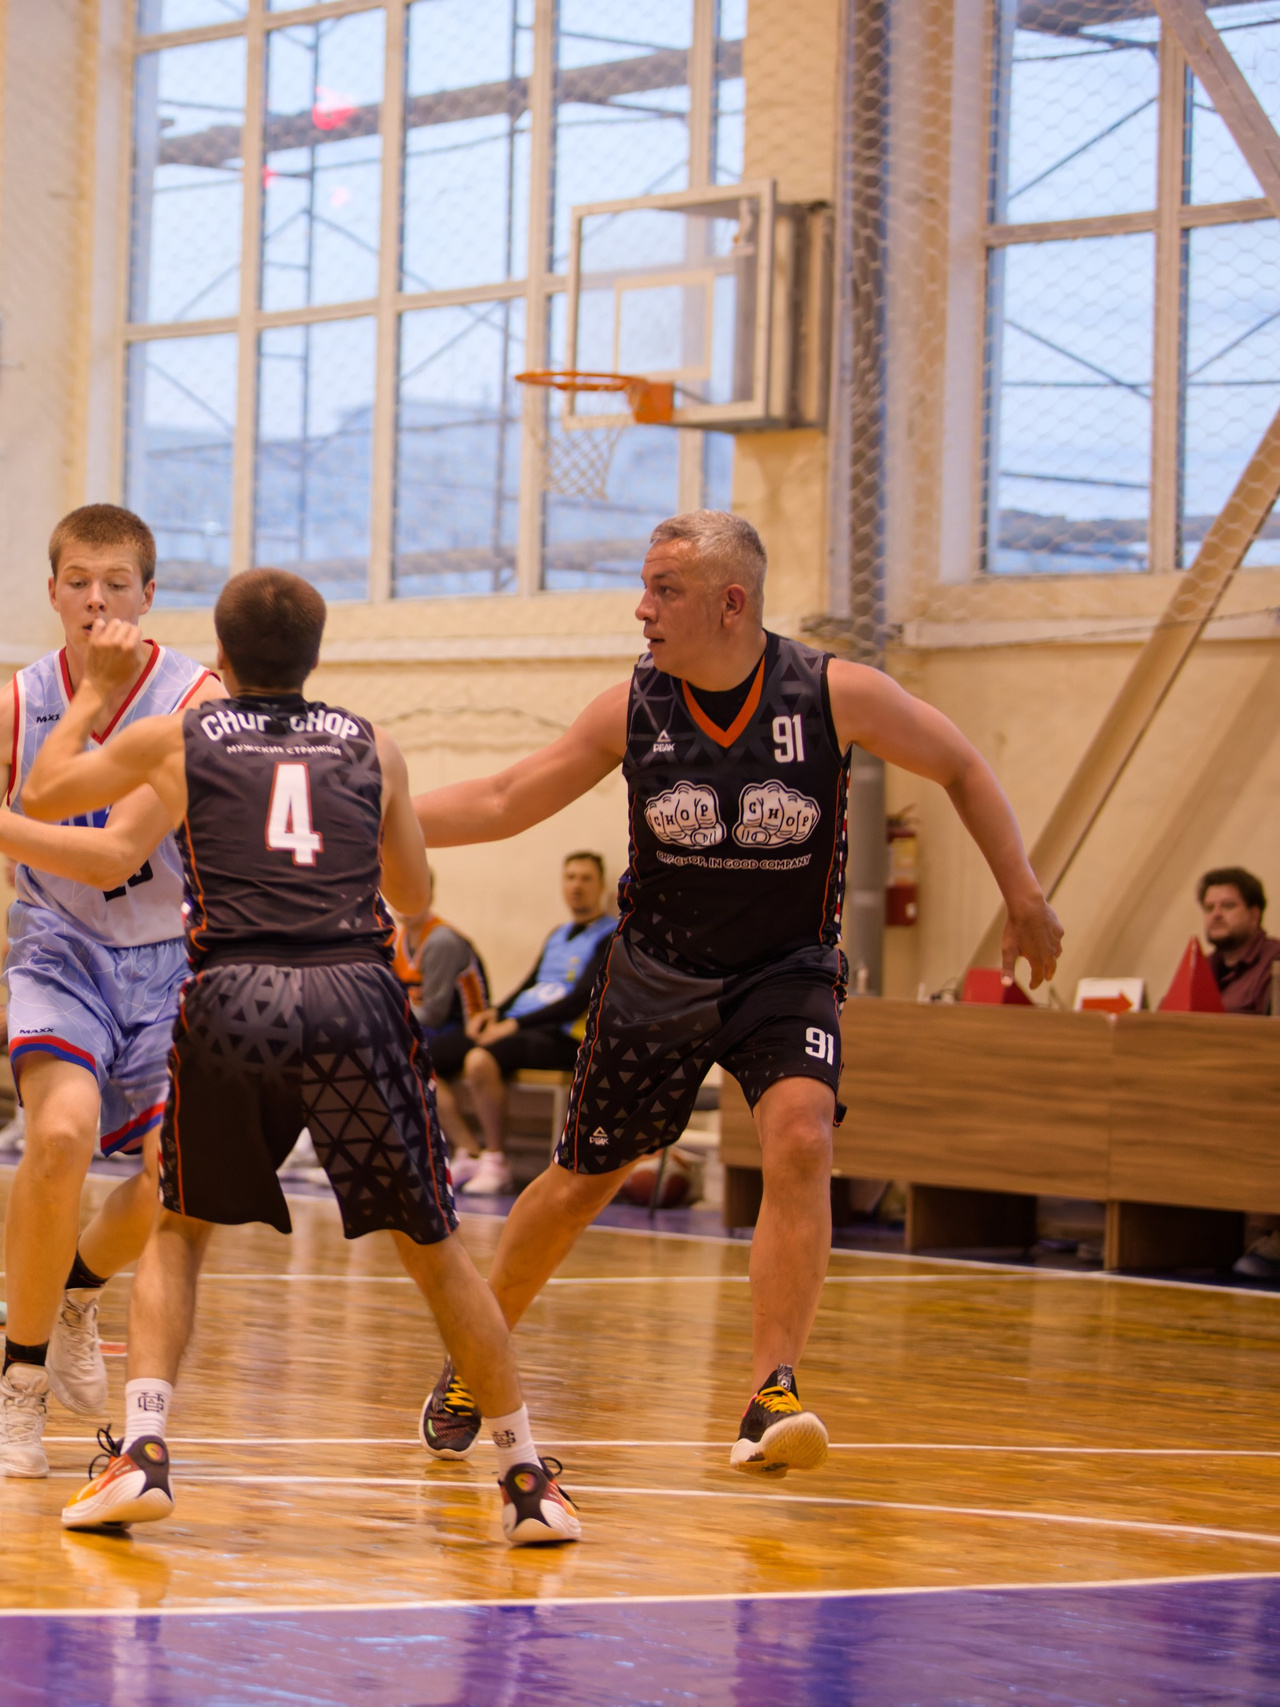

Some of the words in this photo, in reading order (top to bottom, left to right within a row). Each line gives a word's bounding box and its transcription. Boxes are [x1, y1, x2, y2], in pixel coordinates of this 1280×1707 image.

[653, 743, 675, 753] PEAK
[772, 714, 805, 763] 91
[265, 761, 324, 867] 4
[653, 803, 709, 828] CHOP
[749, 801, 809, 828] CHOP
[708, 857, 722, 869] IN
[722, 858, 759, 870] GOOD
[759, 853, 812, 871] COMPANY
[805, 1026, 835, 1066] 91
